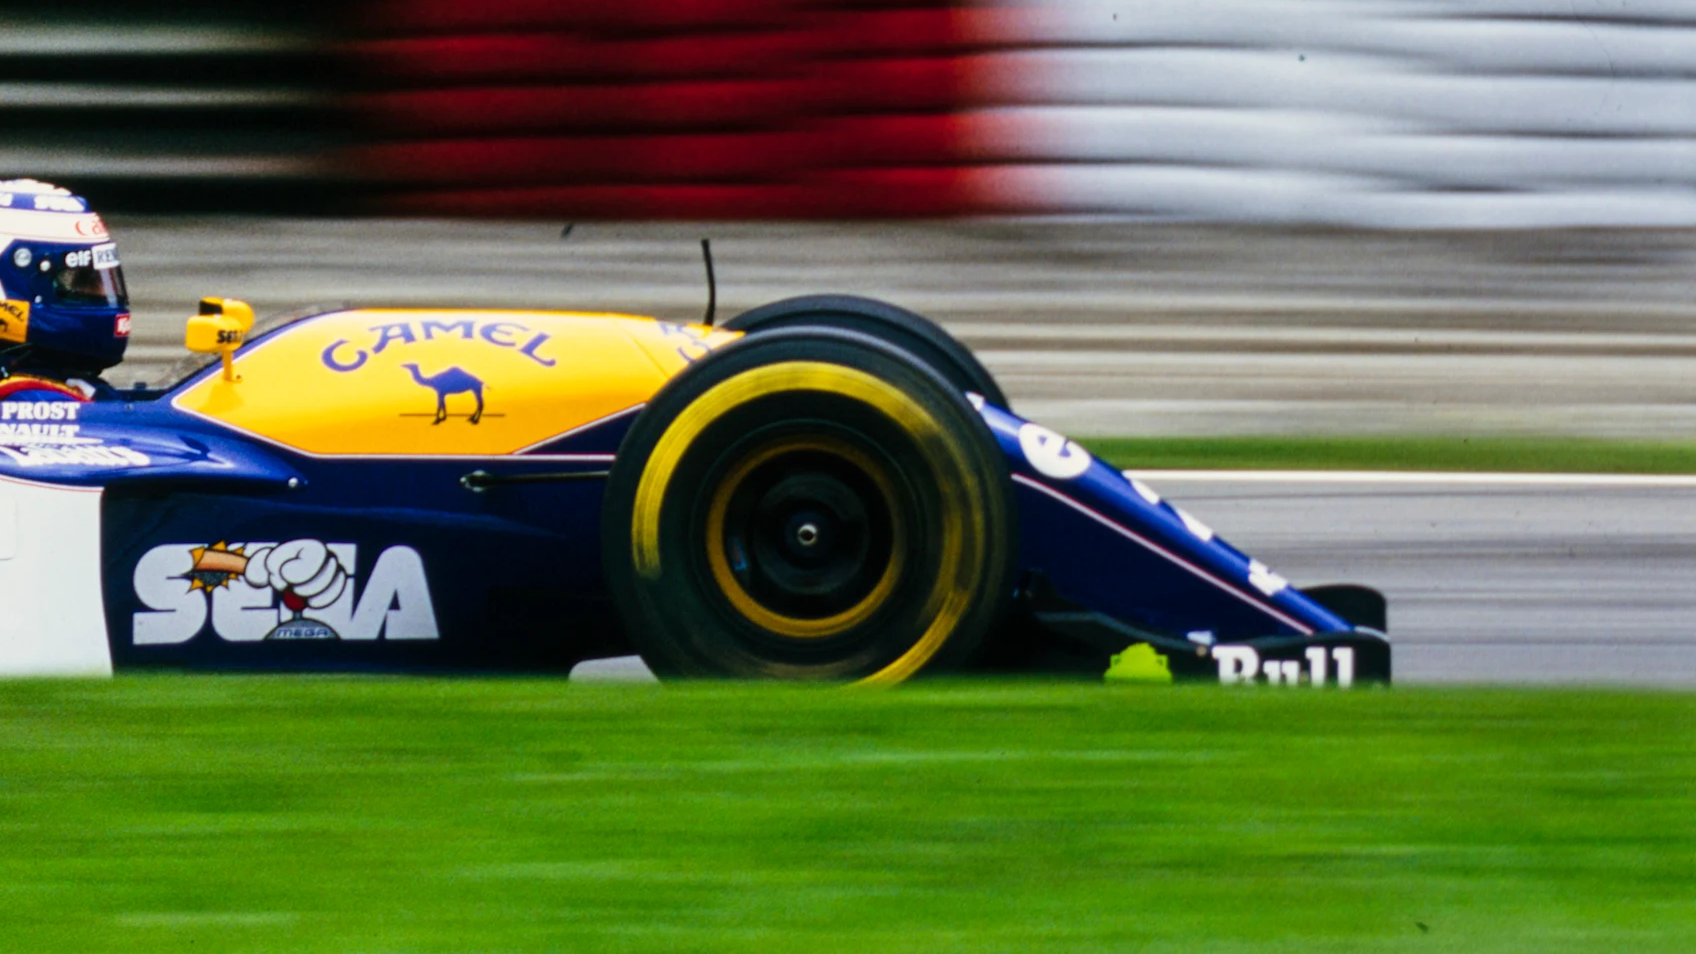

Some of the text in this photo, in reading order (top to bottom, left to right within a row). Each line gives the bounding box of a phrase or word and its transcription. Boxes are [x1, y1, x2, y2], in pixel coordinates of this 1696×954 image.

[65, 250, 91, 268] elf
[321, 320, 557, 372] CAMEL
[1, 401, 80, 420] PROST
